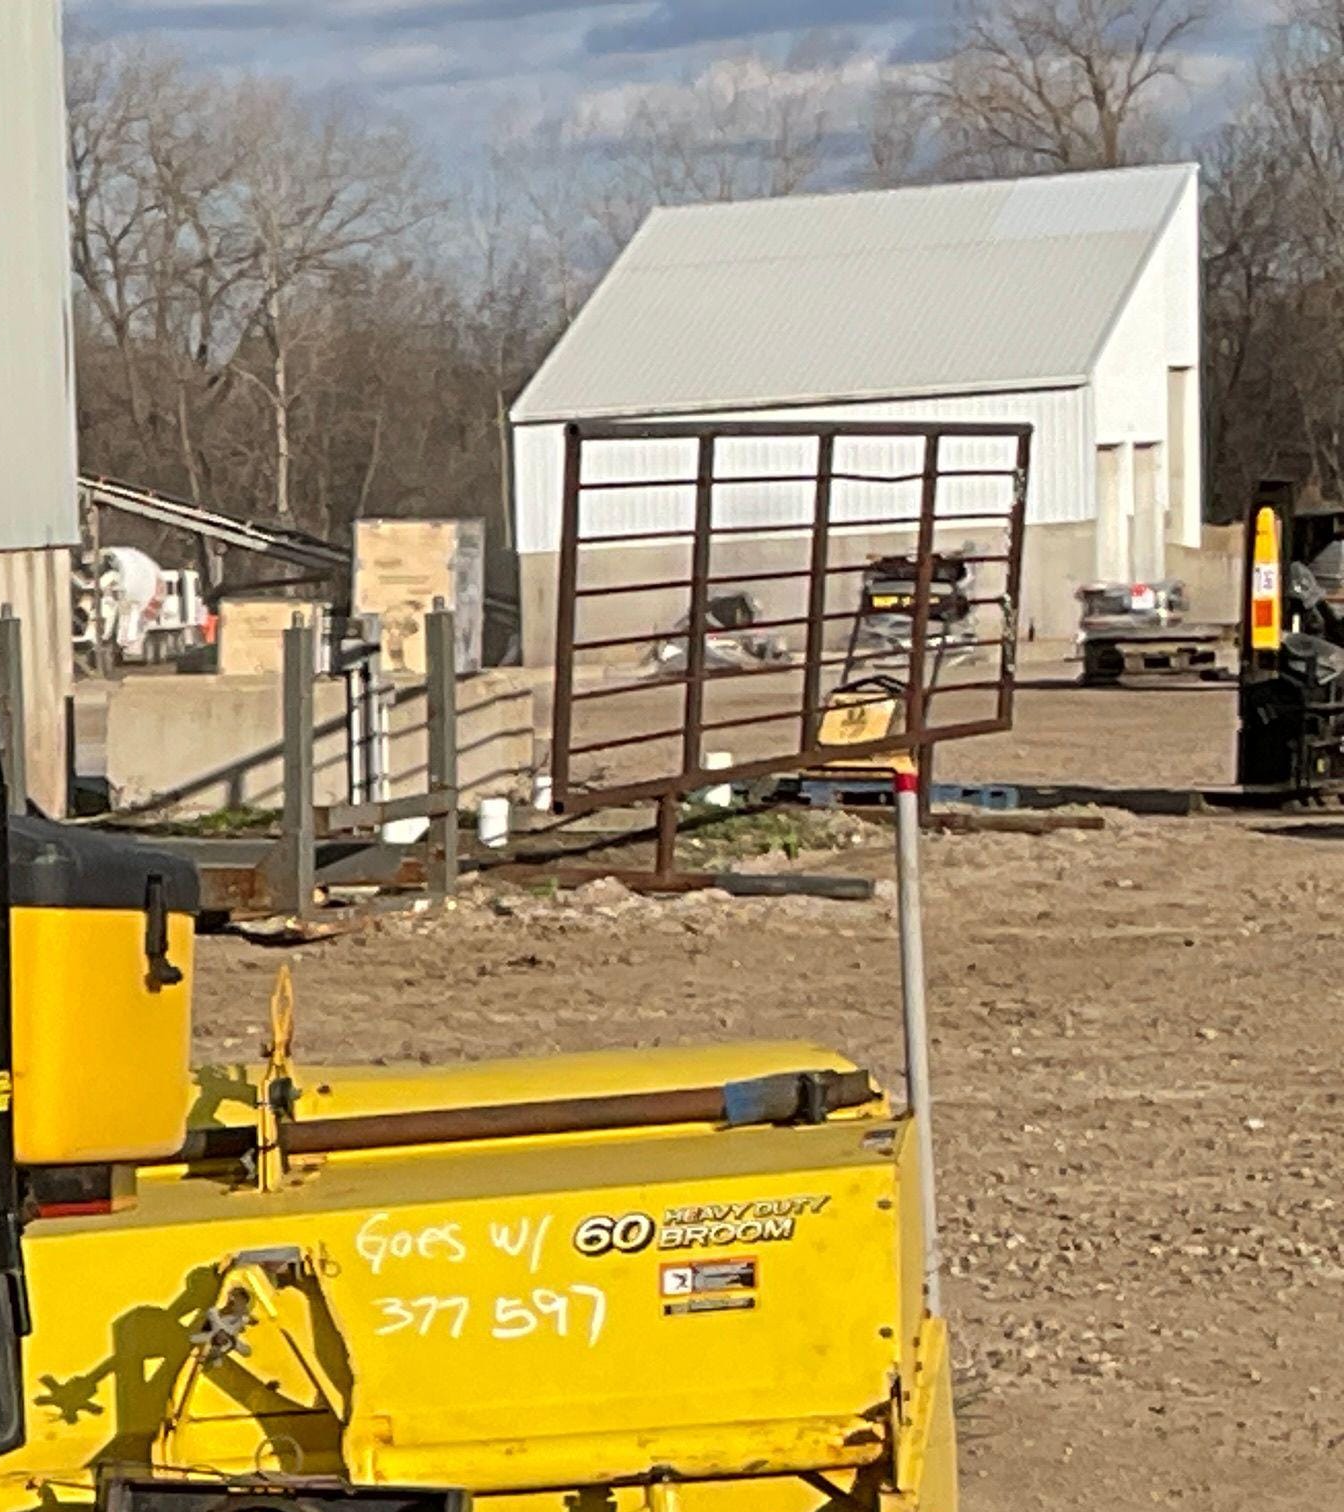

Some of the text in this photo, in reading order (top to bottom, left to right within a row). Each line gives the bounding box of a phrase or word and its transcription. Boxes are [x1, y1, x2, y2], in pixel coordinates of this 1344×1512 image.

[664, 1195, 831, 1225] HEAVY DUTY
[573, 1213, 656, 1257] 60
[658, 1217, 795, 1250] BROOM
